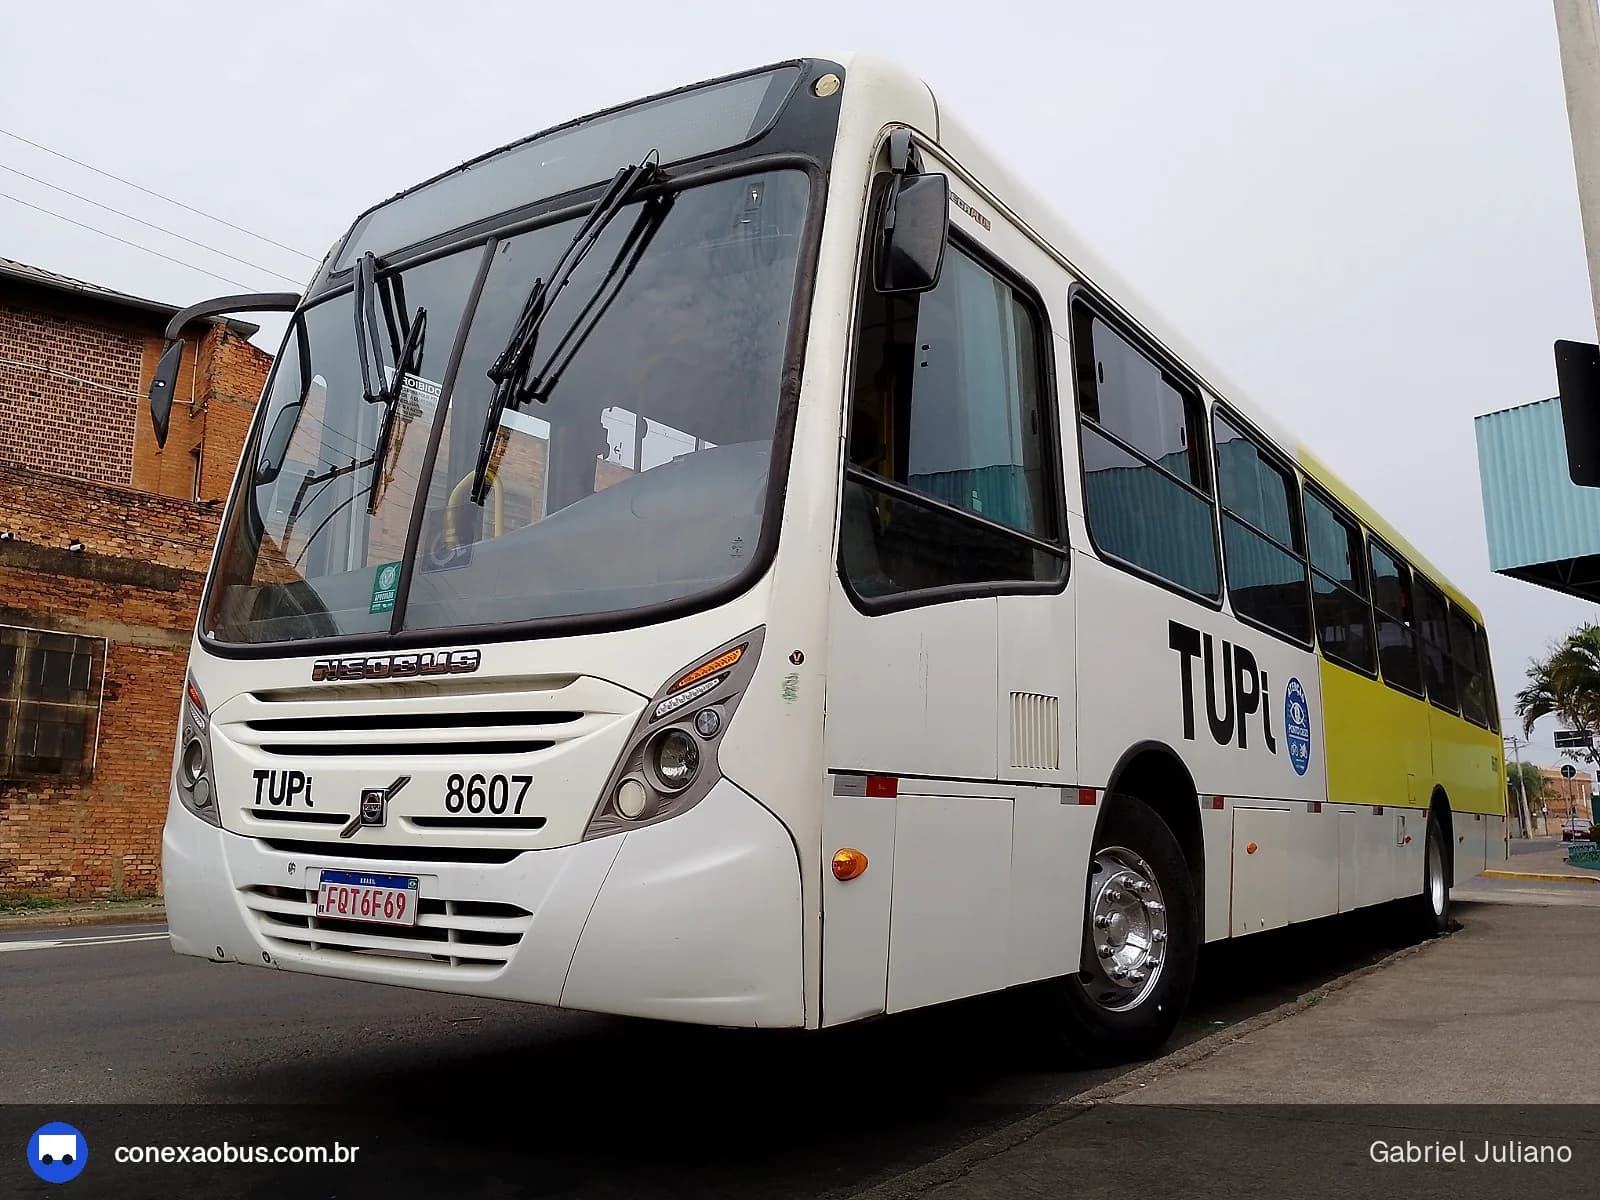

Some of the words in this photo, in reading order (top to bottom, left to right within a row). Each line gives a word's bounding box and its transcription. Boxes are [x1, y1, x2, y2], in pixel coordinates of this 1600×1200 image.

[402, 376, 441, 396] ROIBIDO
[312, 649, 481, 682] NEOBUS
[445, 774, 534, 815] 8607
[326, 886, 406, 919] FQT6F69
